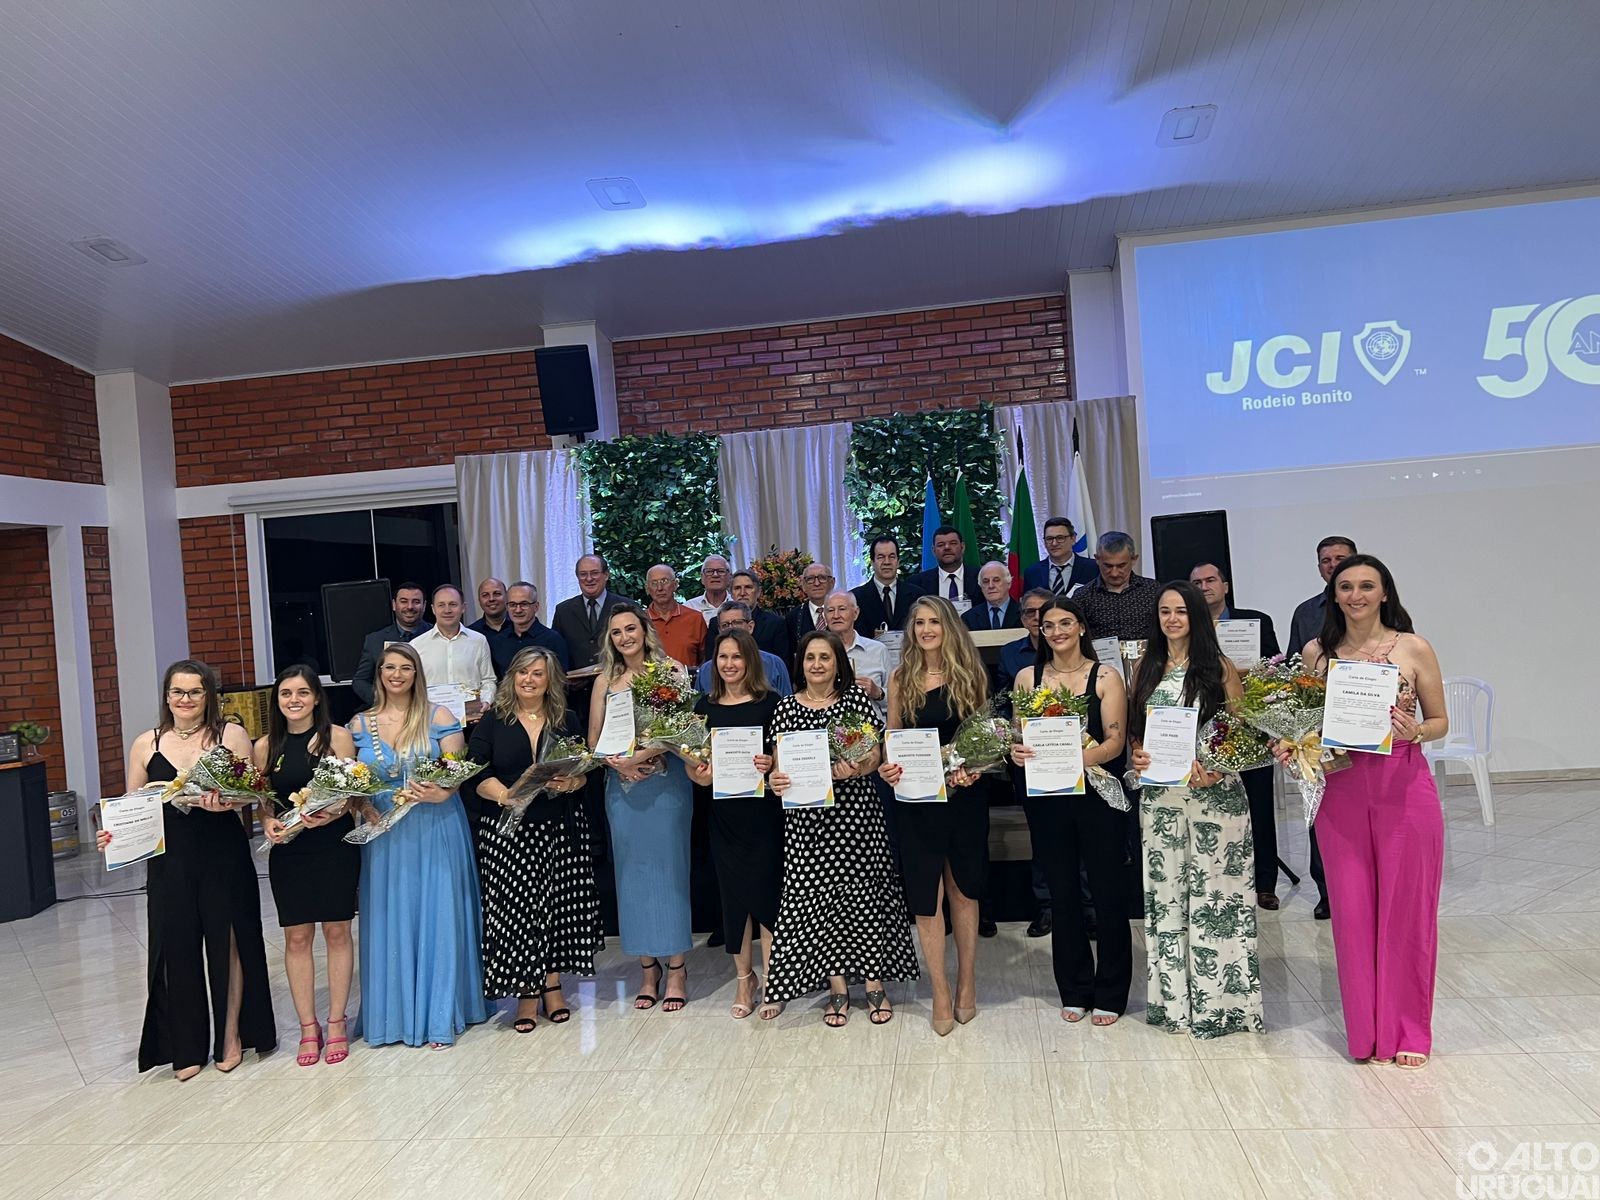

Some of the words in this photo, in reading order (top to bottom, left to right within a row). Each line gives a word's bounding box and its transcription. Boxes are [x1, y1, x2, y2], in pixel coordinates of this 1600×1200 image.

[1206, 331, 1342, 395] JCI
[1242, 392, 1296, 411] Rodeio
[1301, 389, 1352, 406] Bonito
